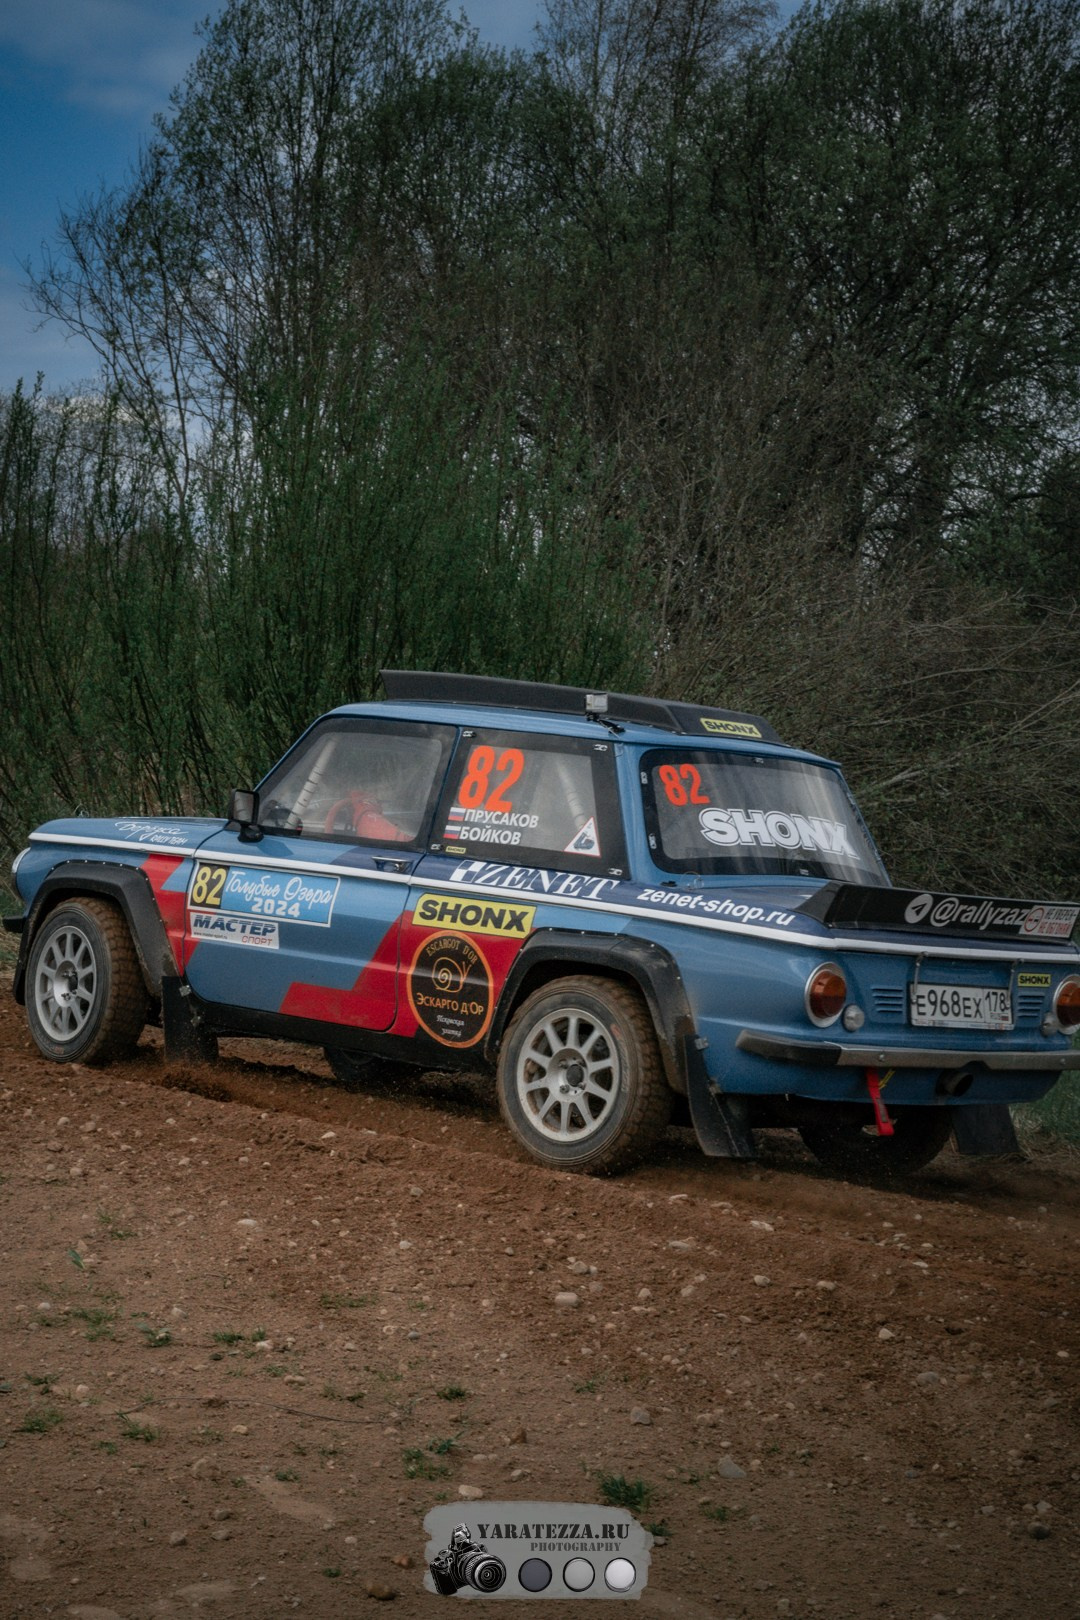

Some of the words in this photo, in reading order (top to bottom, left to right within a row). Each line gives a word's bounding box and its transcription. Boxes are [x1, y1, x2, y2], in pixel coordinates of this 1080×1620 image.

[704, 720, 759, 736] SHONX
[458, 745, 525, 813] 82
[659, 763, 711, 807] 82
[464, 808, 539, 829] ПРУСАКОВ
[459, 824, 522, 845] БОЙКОВ
[699, 807, 861, 860] SHONX
[192, 866, 227, 906] 82
[225, 870, 280, 902] Голубые
[475, 863, 620, 900] ZENET
[251, 897, 301, 918] 2024
[419, 899, 529, 933] SHONX
[636, 888, 796, 926] zenet-shop.ru
[193, 914, 276, 937] МАСТЕР
[241, 935, 273, 946] СПОРТ
[425, 938, 461, 957] ESCARGOT
[1019, 975, 1050, 985] SHONX
